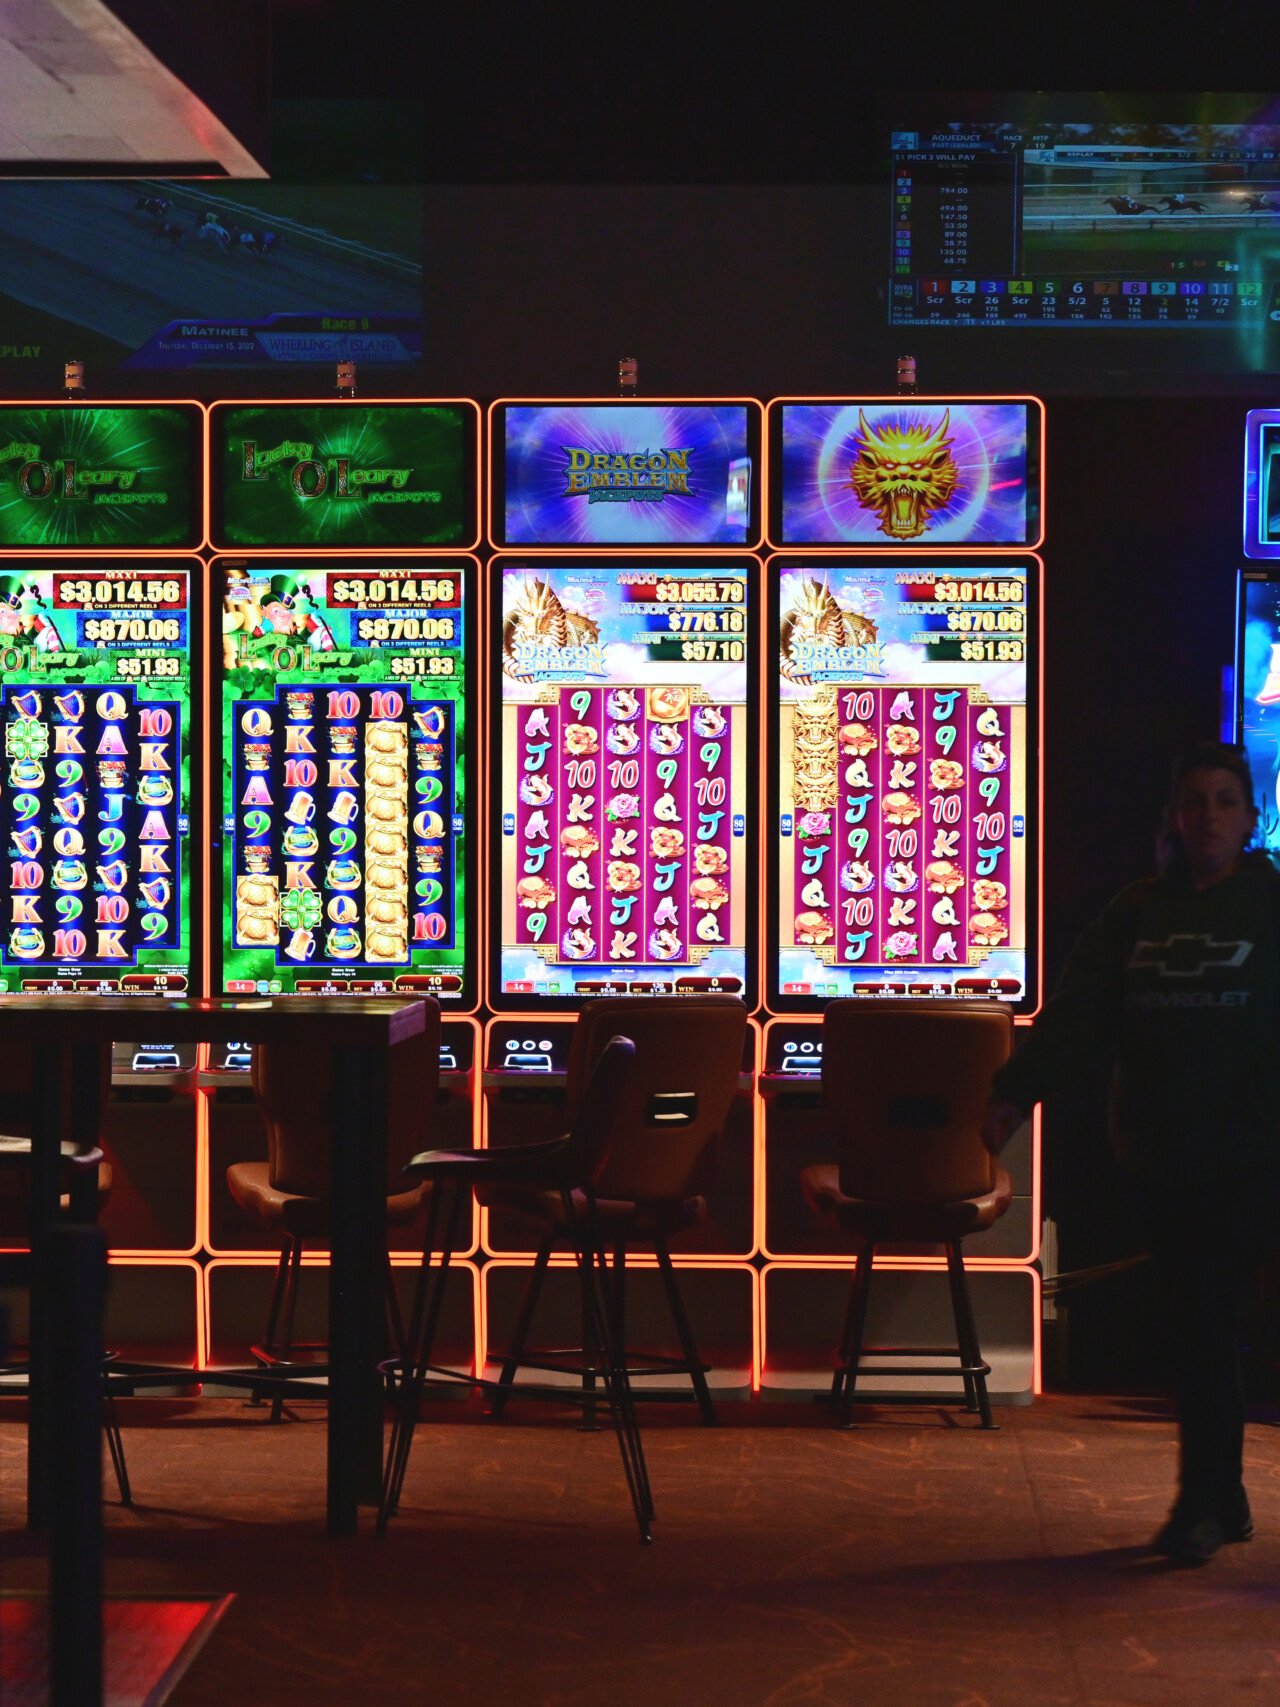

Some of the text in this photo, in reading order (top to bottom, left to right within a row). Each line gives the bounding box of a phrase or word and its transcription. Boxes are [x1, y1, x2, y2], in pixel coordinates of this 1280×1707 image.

[931, 282, 1257, 294] 1 2 3 4 5 6 7 8 9 10 11 12
[926, 296, 944, 304] Scr
[955, 296, 972, 304] Scr
[1068, 297, 1087, 305] 5/2
[182, 326, 248, 336] MATINEE
[322, 318, 369, 330] Race 9
[269, 340, 394, 350] WHEELING ISLAND
[241, 440, 315, 481] Lucky
[561, 447, 694, 472] DRAGON
[566, 472, 691, 493] EMBLEM
[94, 492, 168, 505] JACKPOTS
[368, 491, 442, 503] JACKPOTS
[588, 489, 665, 503] JACKPOTS
[105, 571, 137, 579] MAXI
[379, 570, 412, 579] MAXI
[616, 573, 657, 585] MAXI
[895, 573, 935, 585] MAXI
[60, 581, 180, 603] $3,014.56
[334, 580, 454, 602] $3,014.56
[656, 583, 743, 603] $3,055.79
[934, 583, 1022, 602] $3,014.56
[110, 610, 153, 619] MAJOR
[385, 610, 427, 618] MAJOR
[620, 604, 670, 615] MAJOR
[898, 604, 948, 614] MAJOR
[85, 620, 180, 641] $870.06
[358, 619, 454, 640] $870.06
[668, 612, 743, 631] $776.18
[947, 612, 1022, 631] $870.06
[136, 649, 166, 657] MINI
[238, 633, 288, 660] Lucky
[517, 644, 608, 660] DRAGON
[682, 642, 743, 661] $57.10
[795, 644, 886, 660] DRAGON
[961, 641, 1022, 660] $51.93
[117, 659, 179, 676] $51.93
[391, 658, 454, 676] $51.93
[517, 659, 607, 677] EMBLEM
[795, 659, 885, 677] EMBLEM
[96, 691, 129, 721] Q
[570, 690, 592, 720] 9
[842, 691, 875, 721] 10
[138, 708, 172, 737] 10
[53, 725, 128, 755] K A
